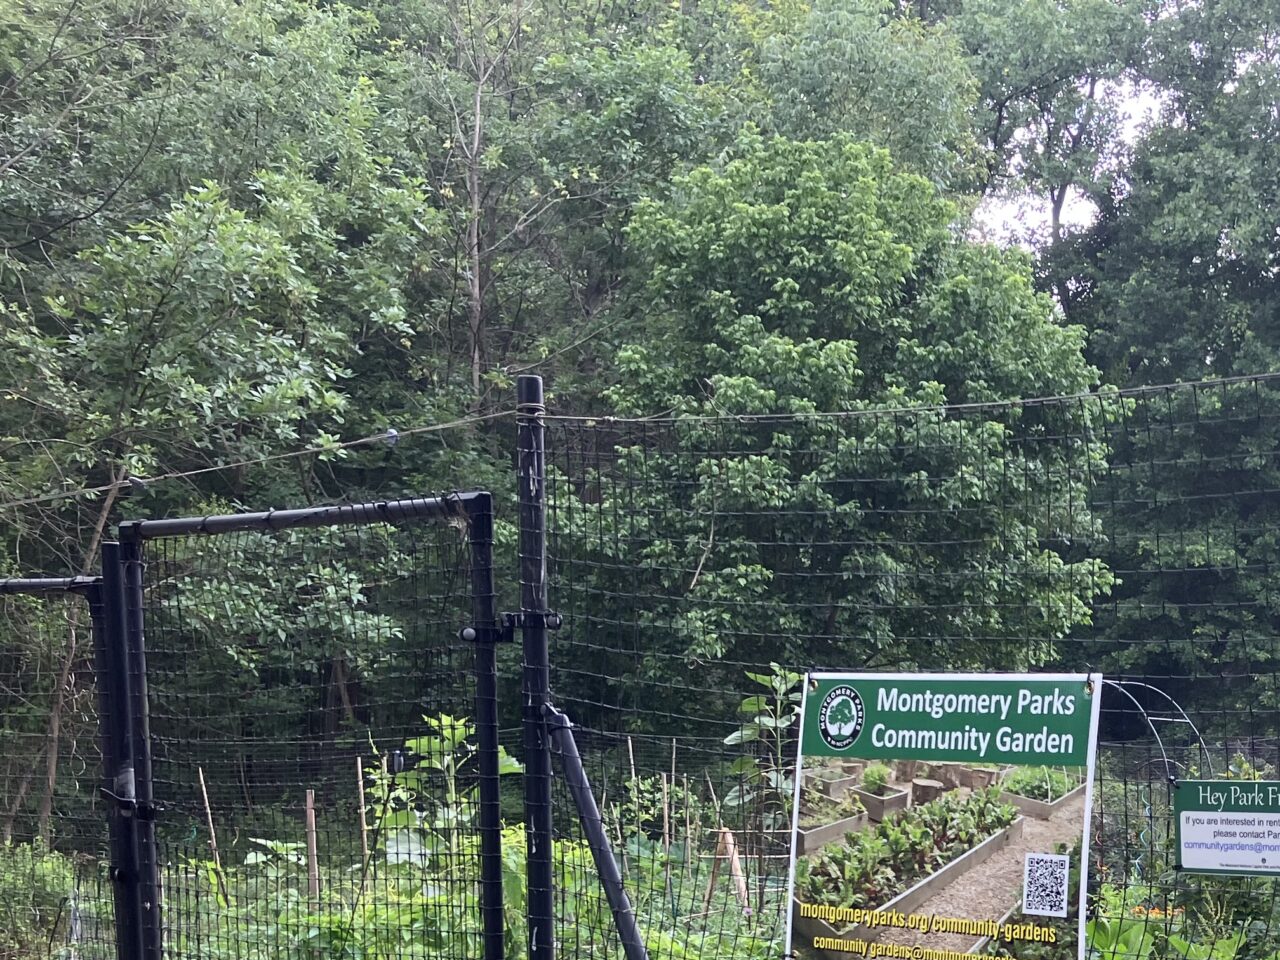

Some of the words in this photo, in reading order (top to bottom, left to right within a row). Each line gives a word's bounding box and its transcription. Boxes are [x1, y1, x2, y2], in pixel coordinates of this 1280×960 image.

[820, 688, 856, 730] MONTGOMERY
[855, 698, 863, 731] PARKS
[877, 687, 1012, 720] Montgomery
[1017, 687, 1076, 716] Parks
[871, 723, 991, 757] Community
[996, 726, 1073, 754] Garden
[1198, 785, 1228, 812] Hey
[1230, 783, 1265, 806] Park
[1185, 816, 1191, 825] If
[1191, 817, 1205, 827] you
[1206, 818, 1219, 826] are
[1220, 817, 1256, 826] interested
[1257, 817, 1265, 826] in
[1213, 829, 1238, 839] please
[1238, 830, 1266, 839] contact
[800, 902, 1057, 944] montgomeryparks.org/community-gardens
[813, 934, 868, 958] community
